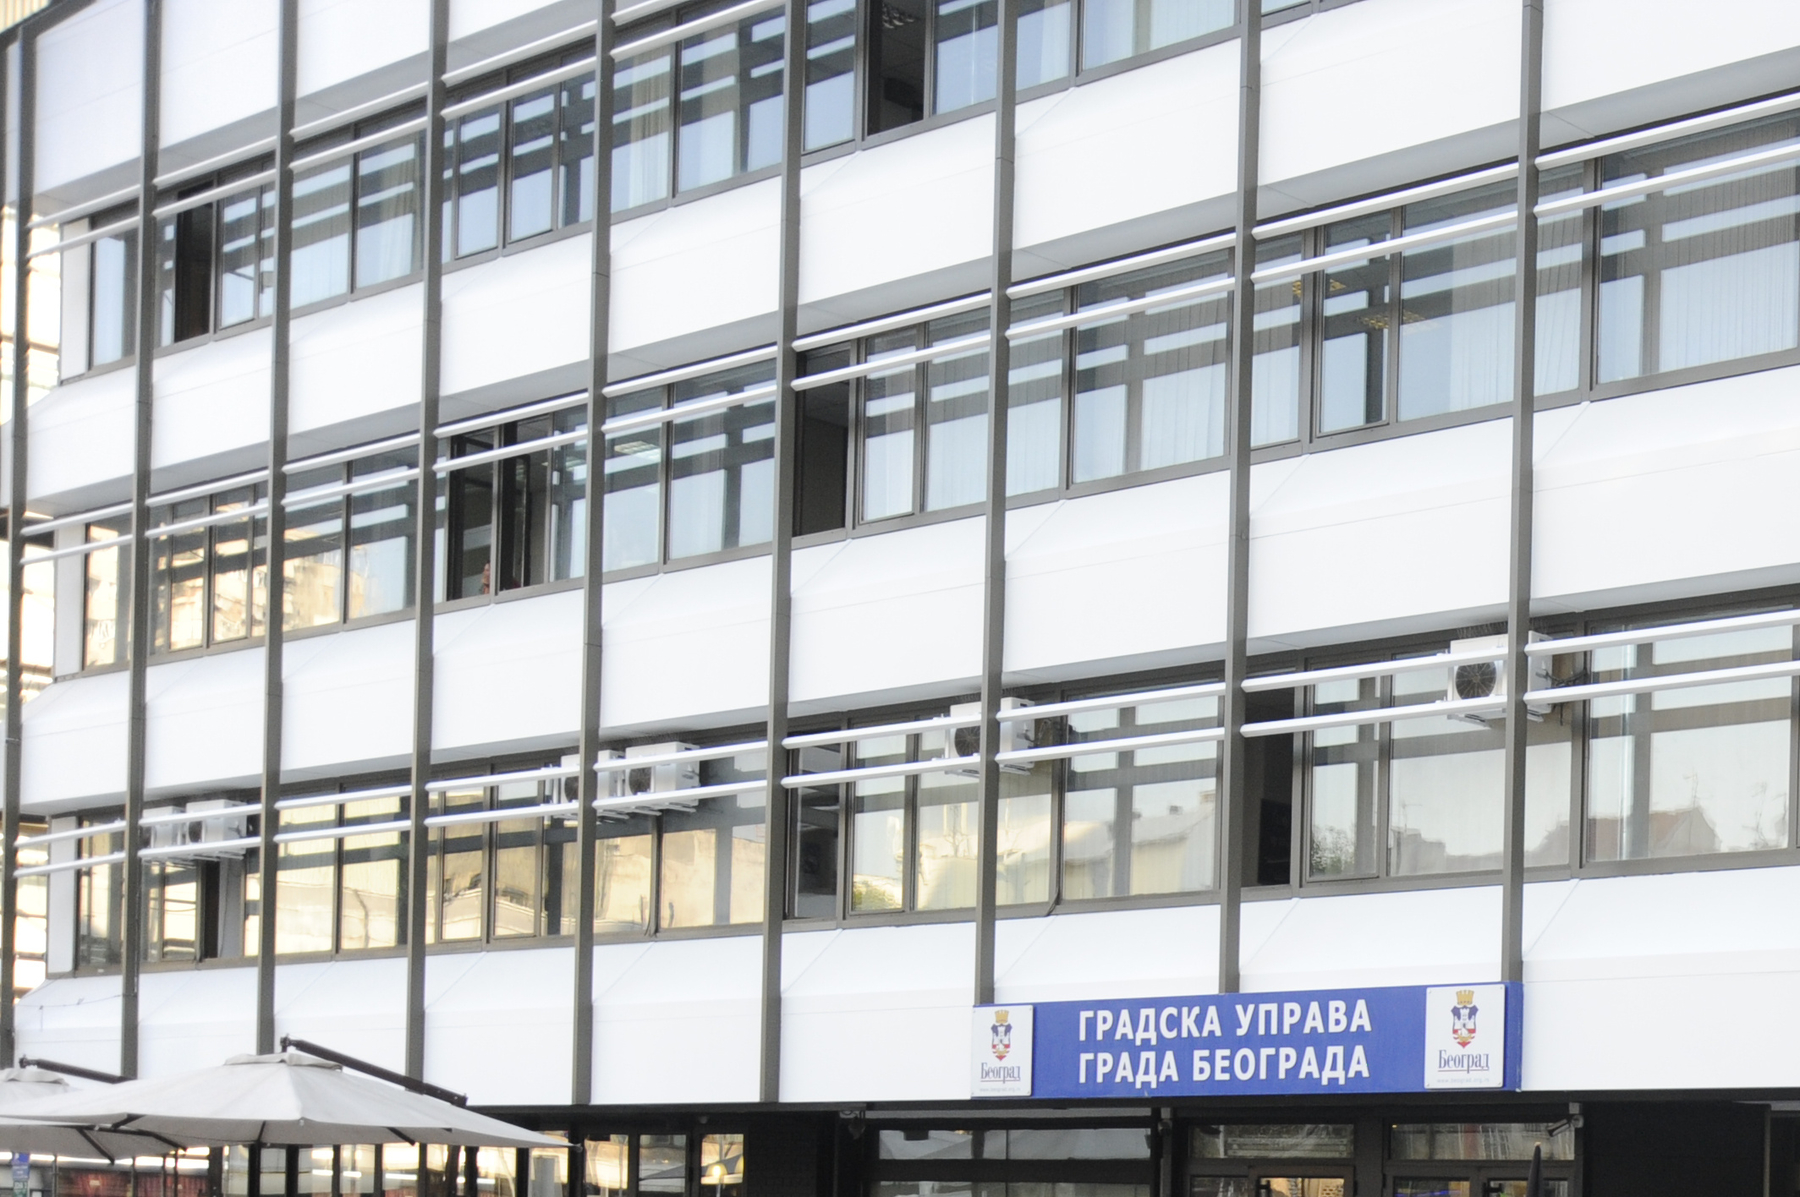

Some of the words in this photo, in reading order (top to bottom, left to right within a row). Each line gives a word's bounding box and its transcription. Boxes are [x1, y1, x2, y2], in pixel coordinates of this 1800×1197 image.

[1079, 1005, 1222, 1047] ГРАДСКА
[1234, 999, 1372, 1037] УПРАВА
[980, 1062, 1021, 1084] Београд
[1079, 1050, 1179, 1089] ГРАДА
[1192, 1044, 1370, 1086] БЕОГРАДА
[1438, 1050, 1490, 1074] Београд
